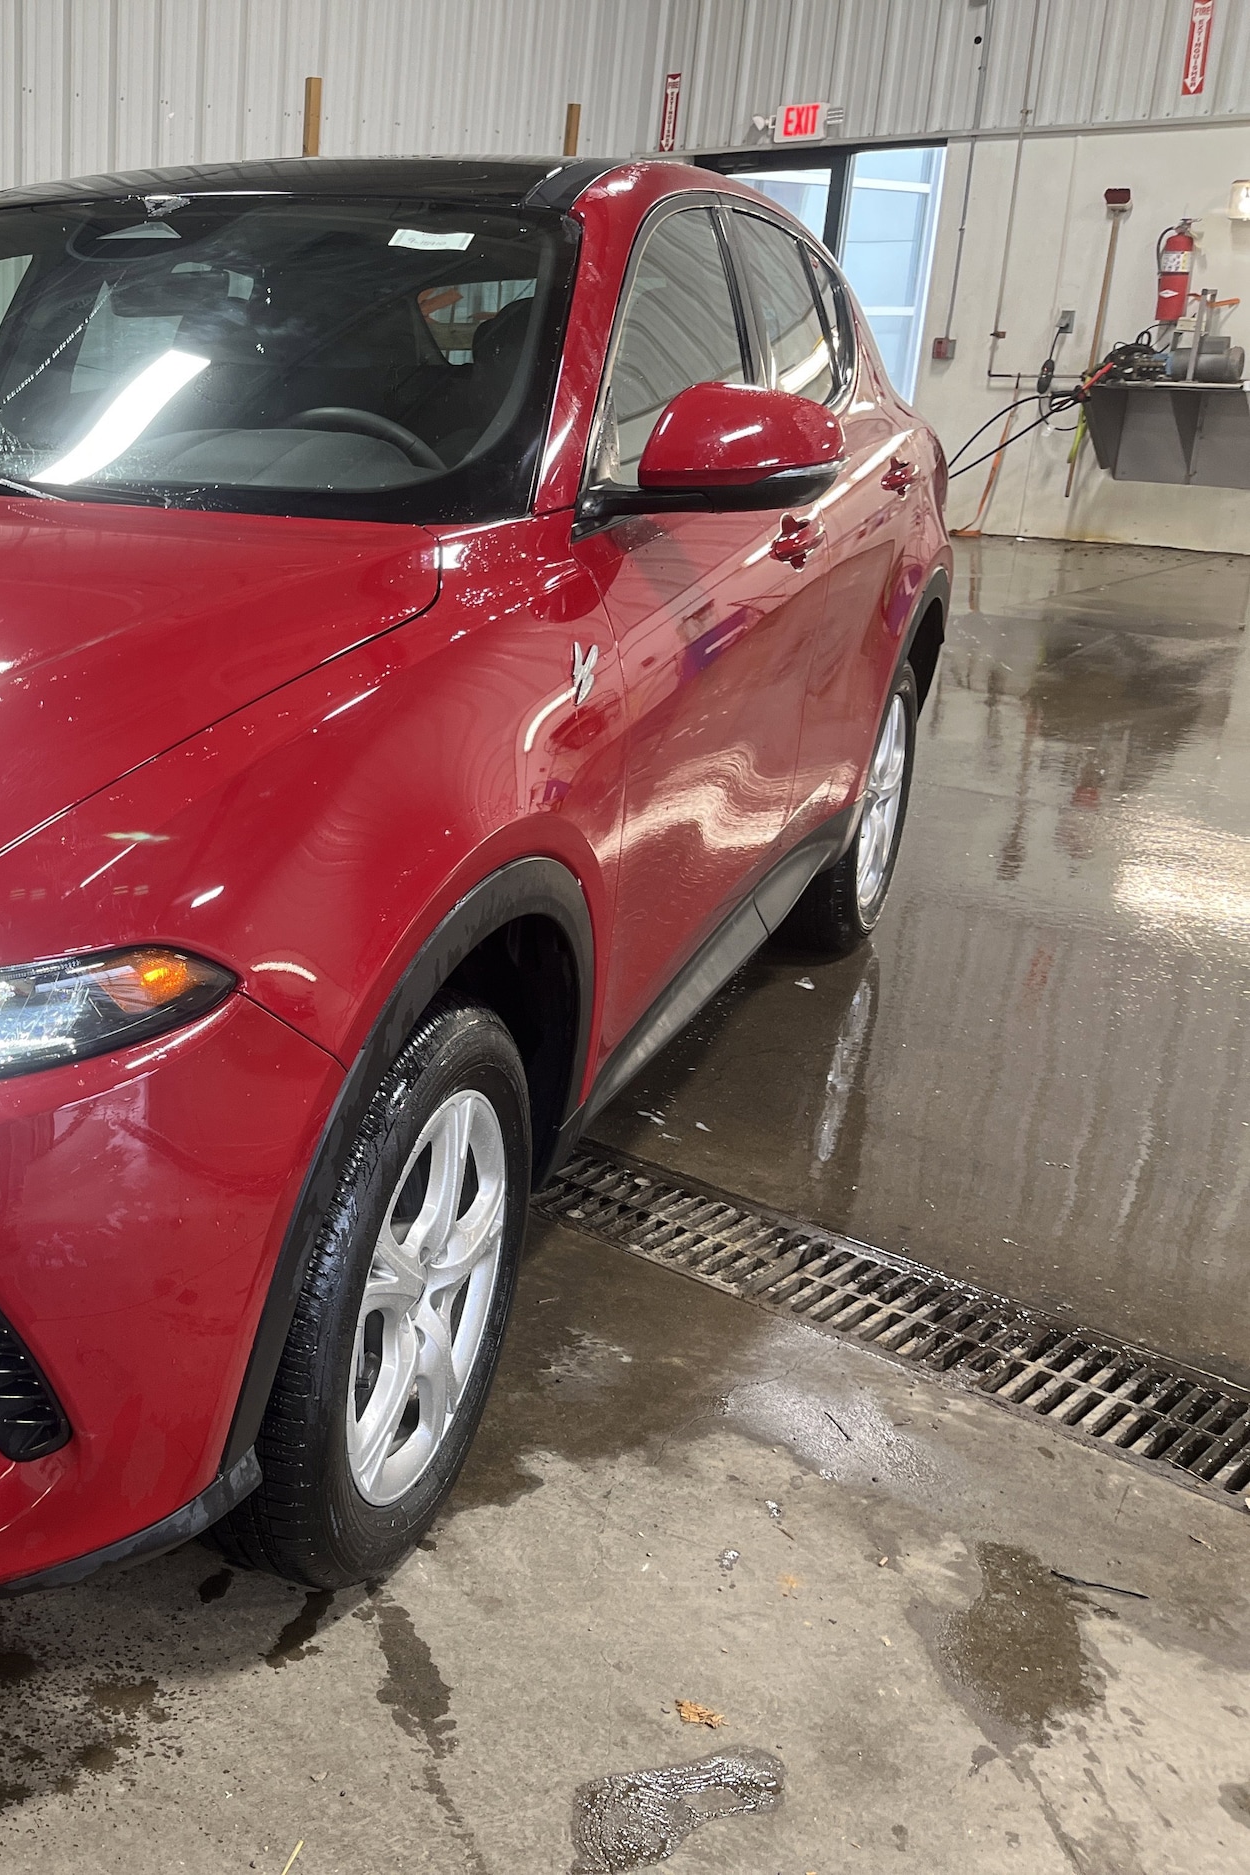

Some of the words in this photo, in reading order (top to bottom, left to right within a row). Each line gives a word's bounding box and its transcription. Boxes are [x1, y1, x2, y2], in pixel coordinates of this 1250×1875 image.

[1194, 7, 1211, 16] FIRE
[1190, 19, 1204, 88] EXTINGUISHER
[664, 91, 675, 148] EXTINGUISHER
[783, 104, 820, 137] EXIT
